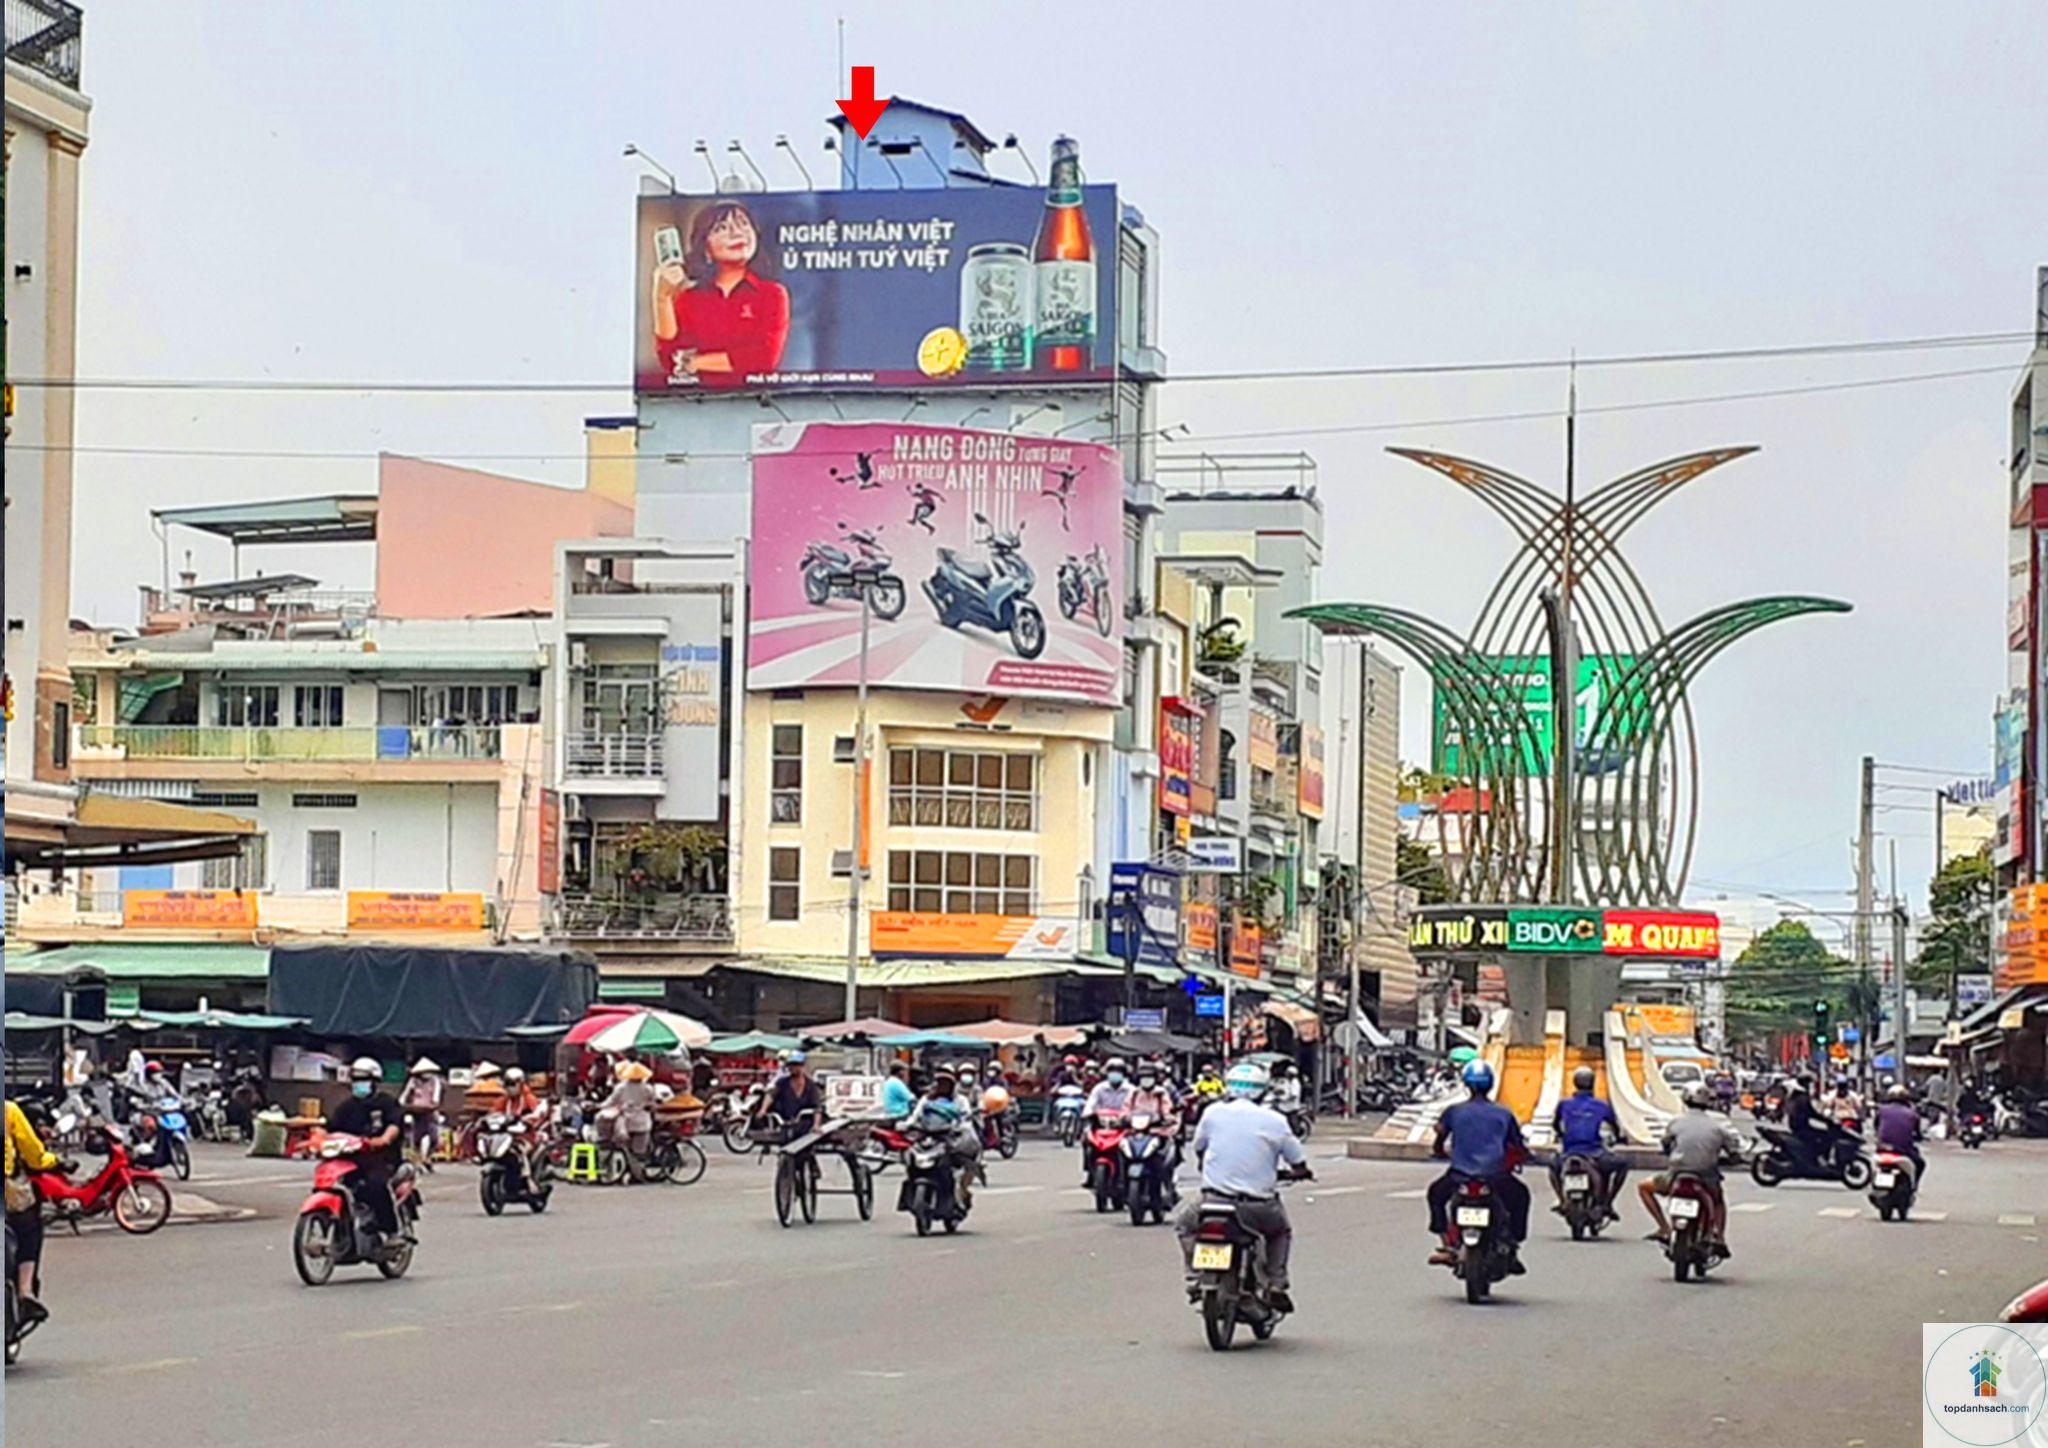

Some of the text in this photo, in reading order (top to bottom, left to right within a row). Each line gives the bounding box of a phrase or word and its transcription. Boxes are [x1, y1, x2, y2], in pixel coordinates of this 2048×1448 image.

[779, 217, 954, 248] NGHỆ NHÂN VIỆT
[803, 251, 852, 269] TINH
[857, 245, 900, 268] TUÝ
[903, 245, 950, 273] VIỆT
[1515, 921, 1574, 944] BIDV
